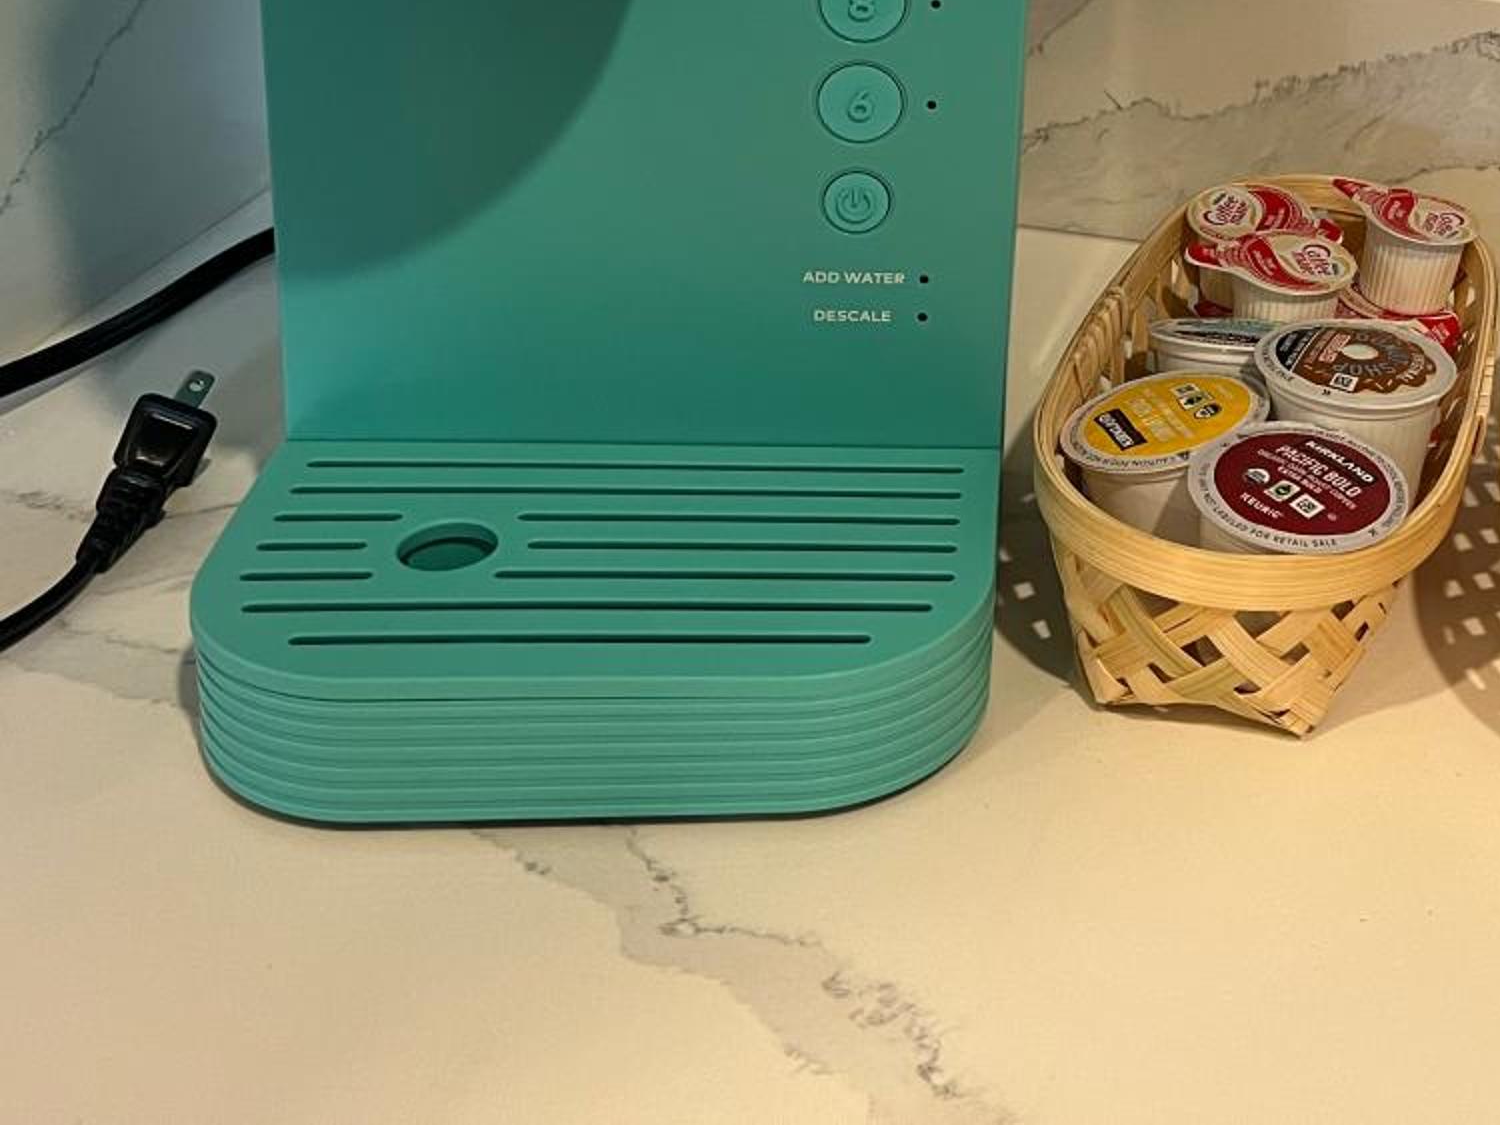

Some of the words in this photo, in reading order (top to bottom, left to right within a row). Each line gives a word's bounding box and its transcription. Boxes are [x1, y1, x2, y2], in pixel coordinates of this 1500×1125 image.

[847, 91, 874, 123] 6
[802, 270, 841, 284] ADD
[843, 271, 906, 284] WATER
[813, 310, 892, 322] DESCALE
[1275, 445, 1329, 476] PACIFIC
[1322, 470, 1362, 498] BOLD
[1304, 440, 1375, 484] KIRKLAND
[1273, 535, 1310, 548] RETAIL
